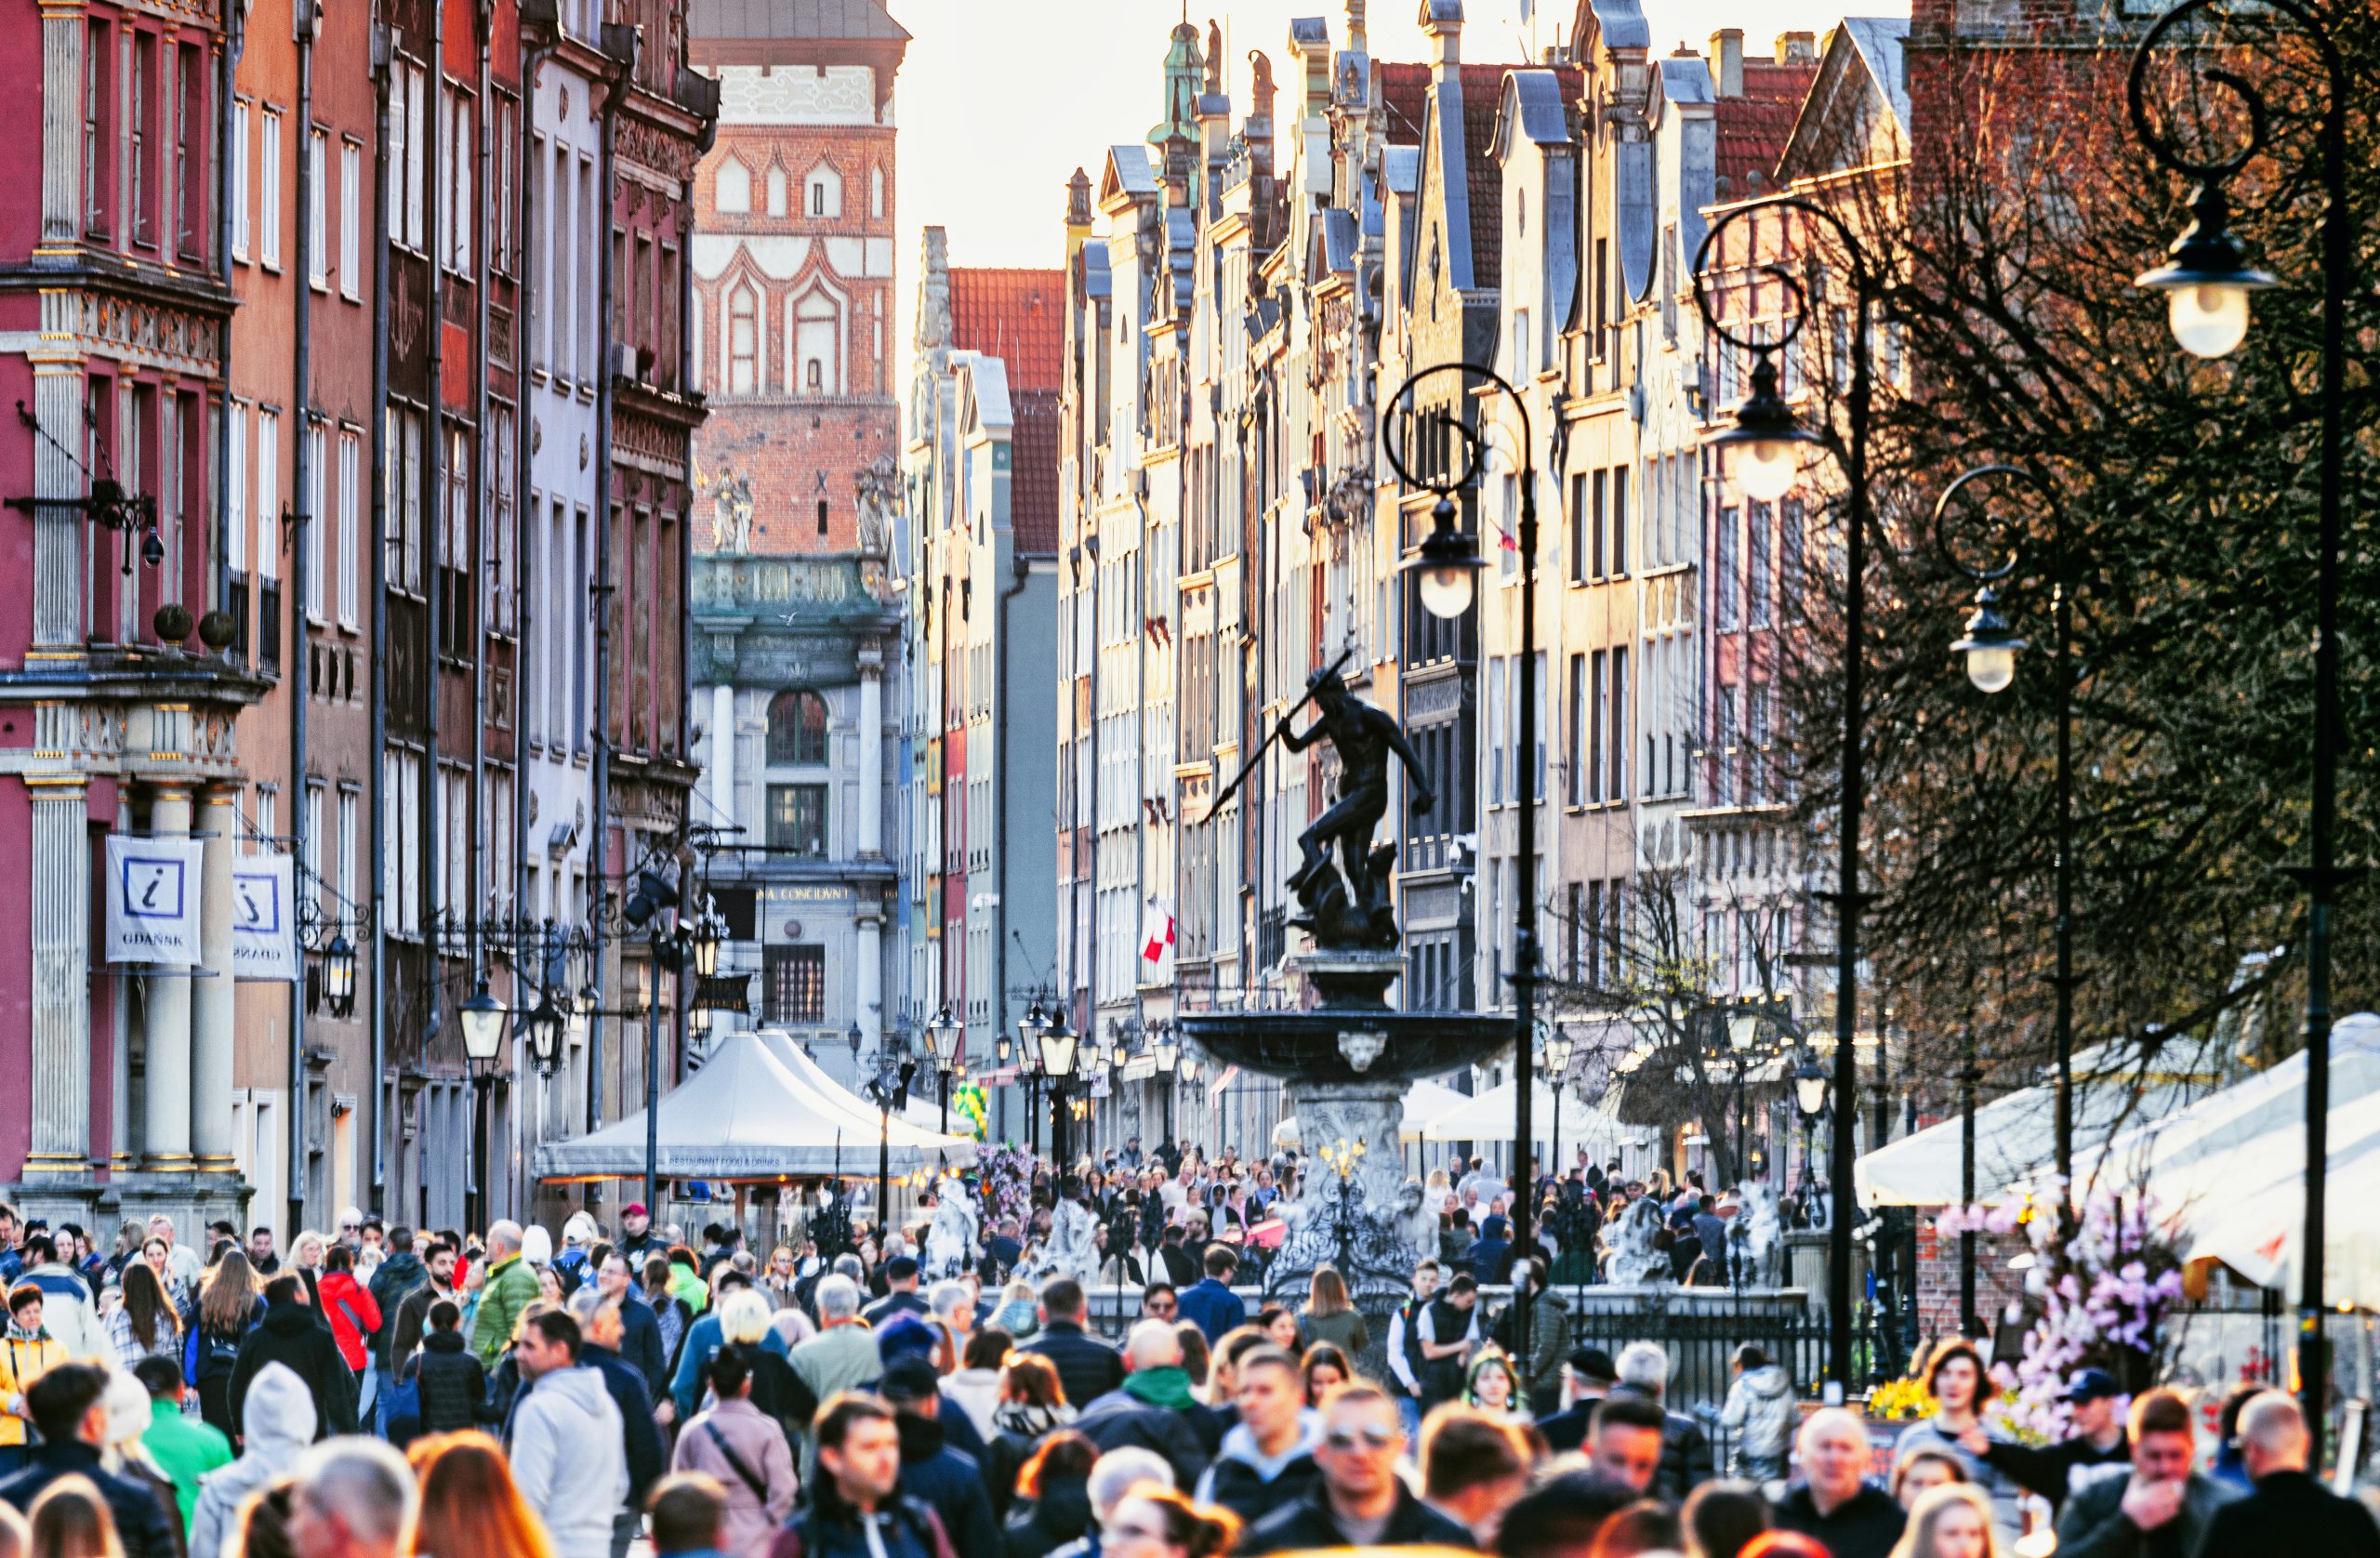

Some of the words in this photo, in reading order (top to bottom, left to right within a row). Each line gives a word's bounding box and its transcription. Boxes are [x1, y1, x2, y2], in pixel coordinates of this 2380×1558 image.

[122, 931, 183, 946] GDAŃSK
[669, 1155, 719, 1166] RESTAURANT
[721, 1155, 743, 1167] FOOD
[751, 1156, 780, 1167] DRINKS
